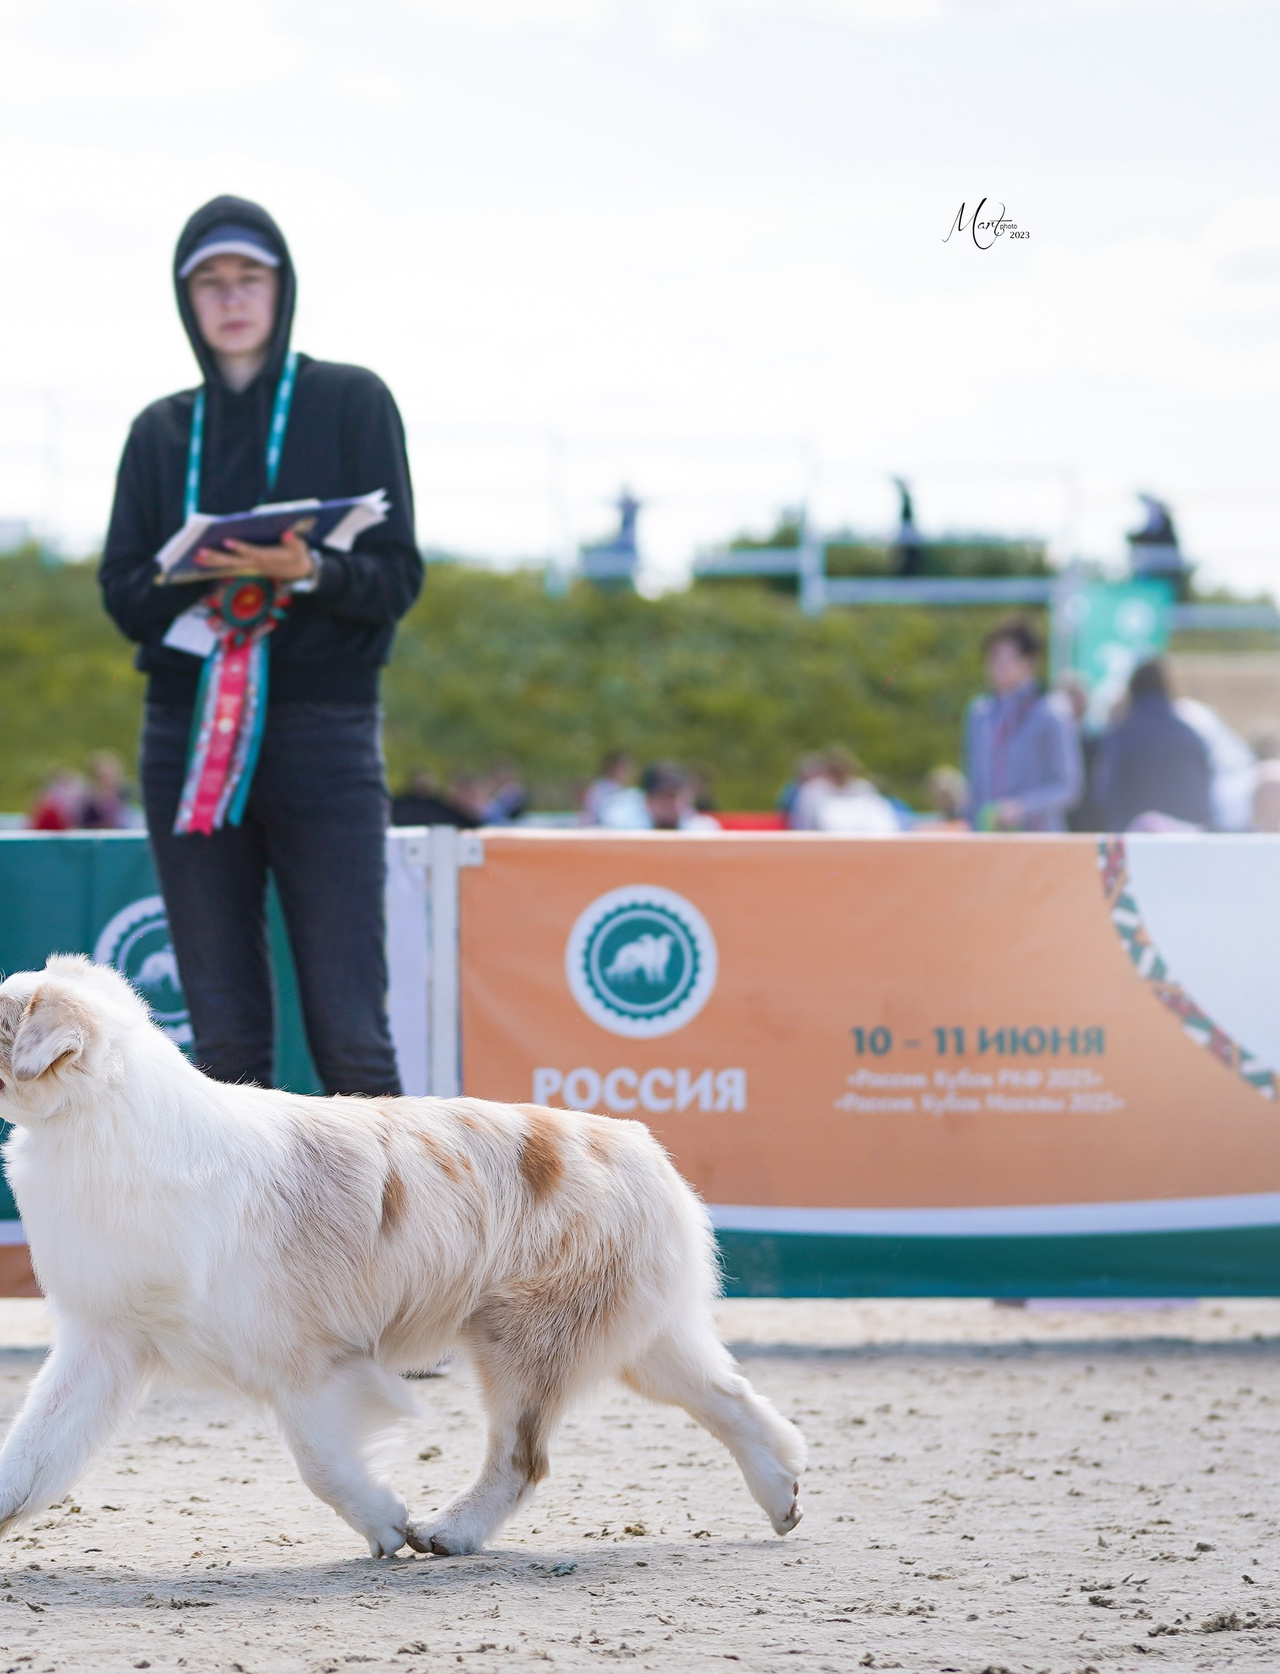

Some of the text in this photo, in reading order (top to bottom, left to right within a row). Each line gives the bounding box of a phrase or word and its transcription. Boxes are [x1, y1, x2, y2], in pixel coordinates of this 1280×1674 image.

[851, 1026, 893, 1056] 10
[931, 1026, 965, 1056] 11
[977, 1026, 1106, 1056] ИЮНЯ
[532, 1066, 748, 1112] РОССИЯ
